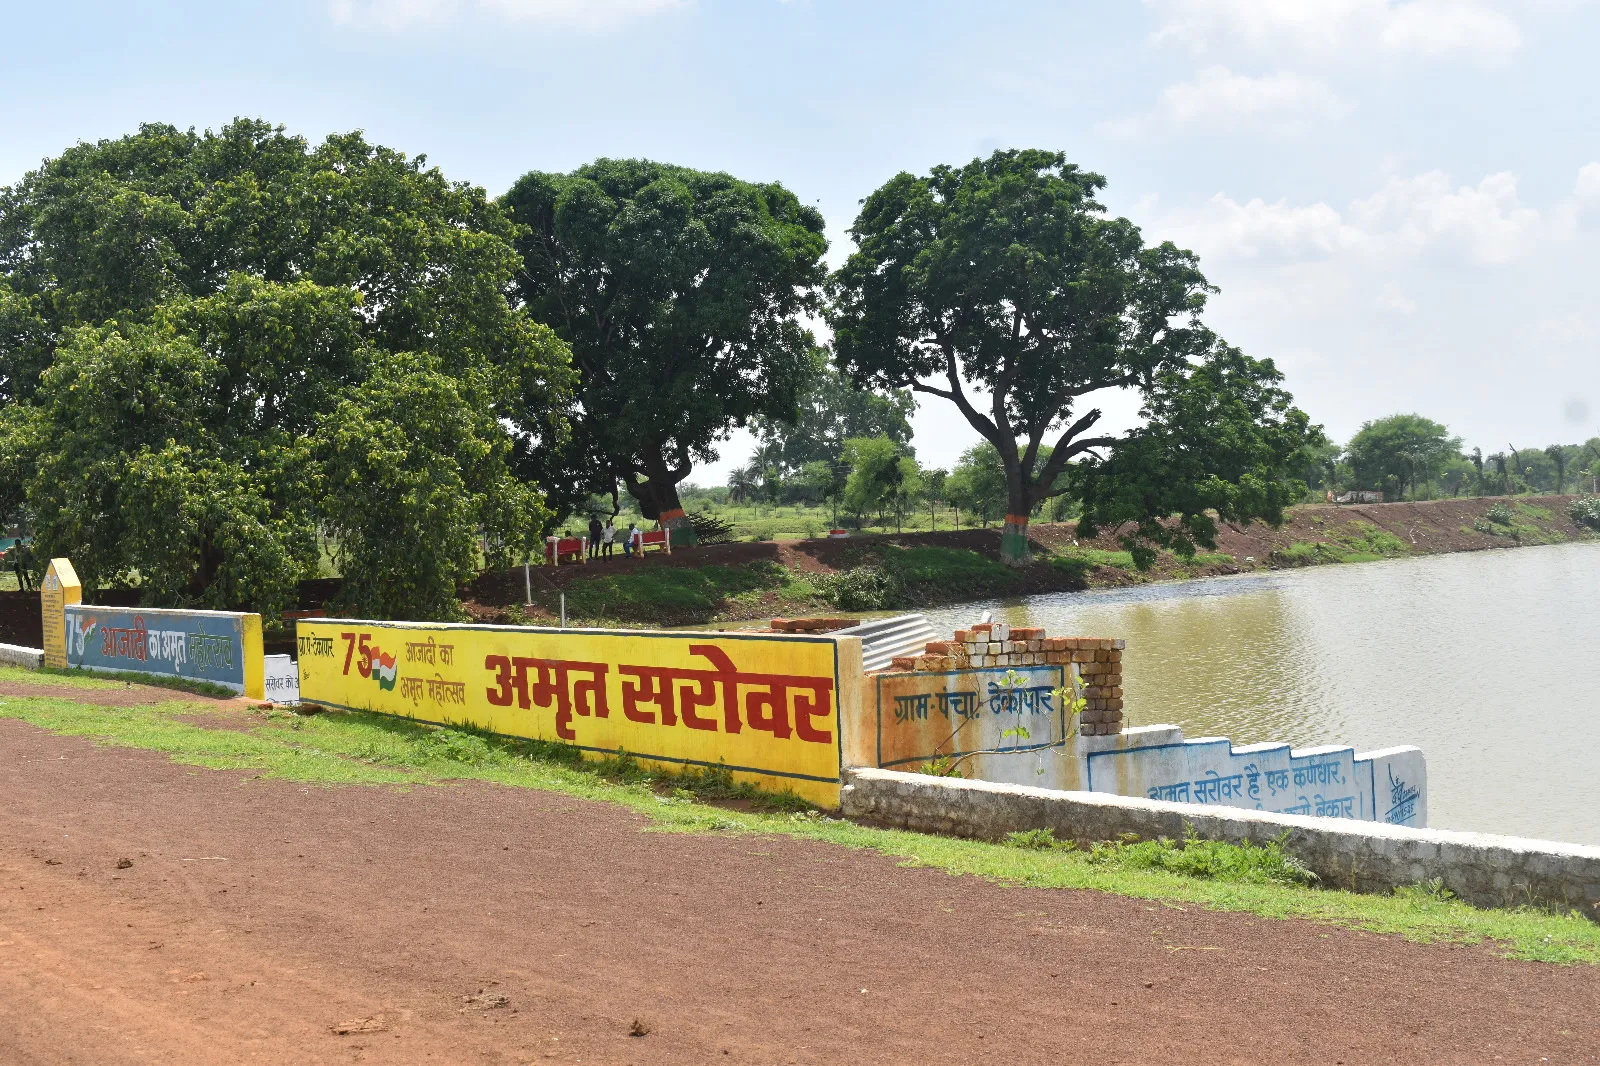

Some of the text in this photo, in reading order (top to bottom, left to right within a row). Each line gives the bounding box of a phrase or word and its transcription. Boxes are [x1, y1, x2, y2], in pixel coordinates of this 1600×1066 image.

[100, 615, 148, 662] आजादी
[148, 630, 161, 659] का
[161, 630, 187, 672] अमृत
[187, 621, 233, 671] महोत्सव
[341, 632, 373, 679] 75
[405, 636, 454, 666] आजादी का
[401, 673, 466, 707] अमृत महोत्सव
[485, 644, 833, 744] अमृत सरोवर
[1194, 769, 1243, 804] सरोवर
[1245, 763, 1260, 801] है
[1264, 769, 1290, 796] एक
